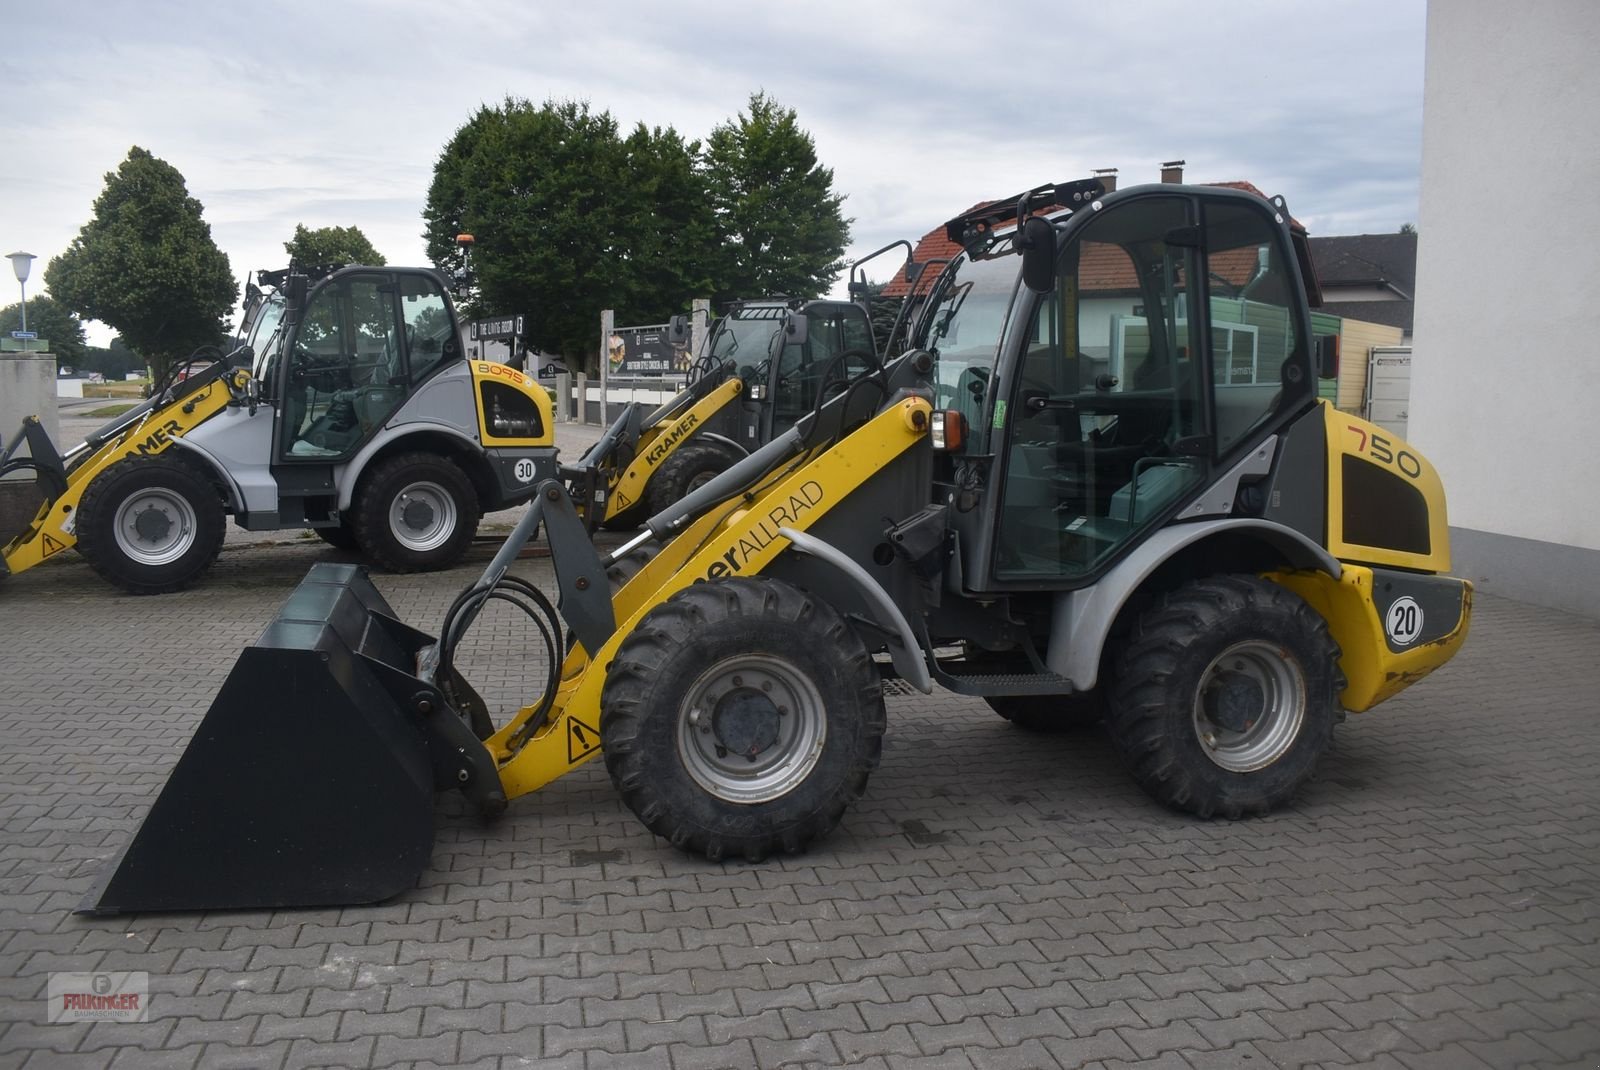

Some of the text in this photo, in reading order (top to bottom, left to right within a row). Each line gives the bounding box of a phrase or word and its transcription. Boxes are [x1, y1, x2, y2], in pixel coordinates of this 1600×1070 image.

[501, 320, 513, 333] ROOM
[479, 364, 523, 384] 8095
[645, 413, 699, 467] KRAMER
[1347, 425, 1421, 479] 750
[518, 462, 532, 478] 30
[1393, 605, 1416, 636] 20
